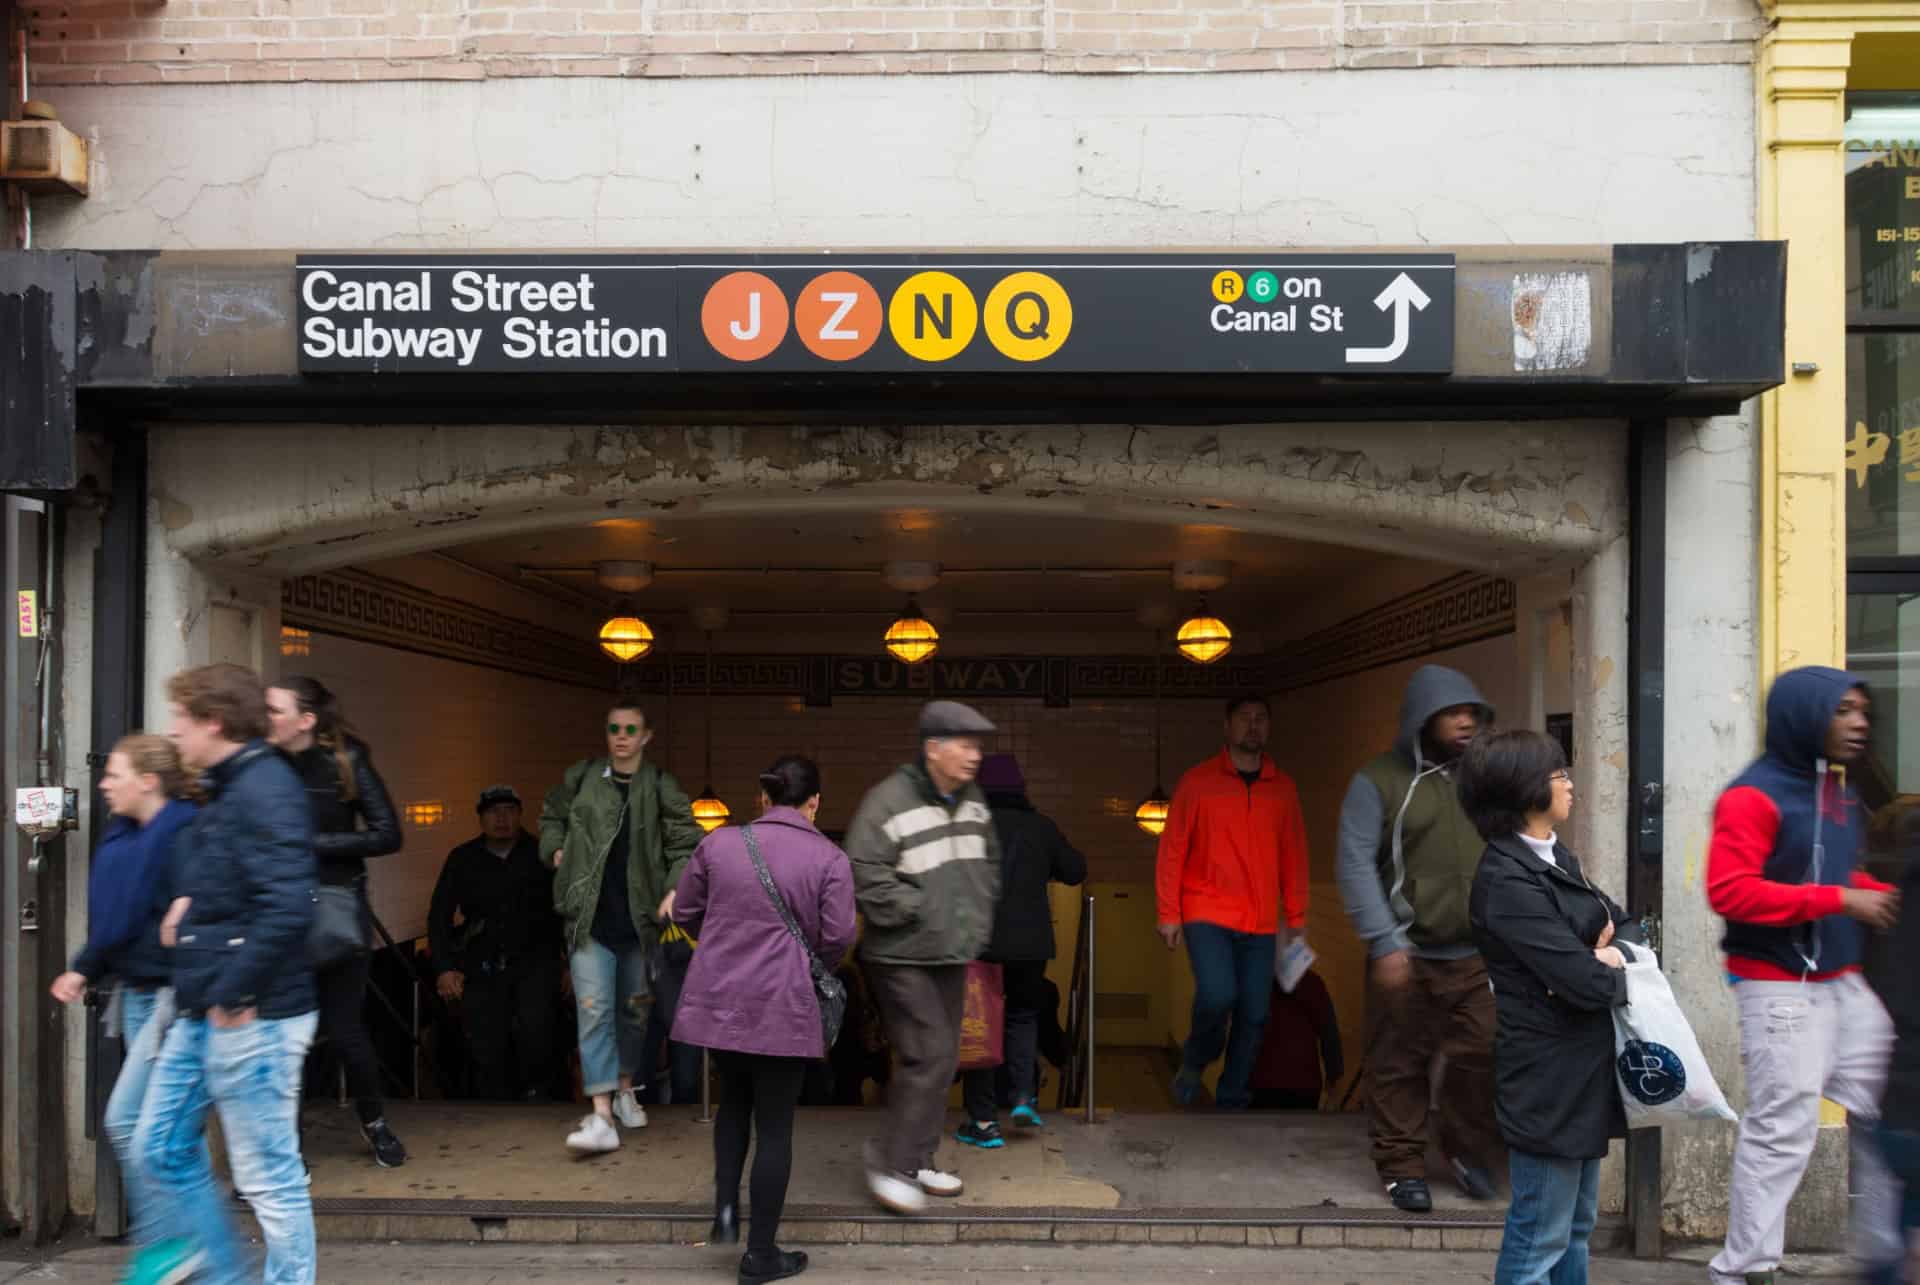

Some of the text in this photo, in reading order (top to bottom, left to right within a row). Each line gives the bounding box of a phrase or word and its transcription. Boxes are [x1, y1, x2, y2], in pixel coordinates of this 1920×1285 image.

[303, 271, 594, 312] Canal Street
[1283, 278, 1321, 298] on
[1211, 304, 1343, 332] Canal St
[304, 317, 666, 365] Subway Station
[20, 596, 33, 633] EASY
[840, 663, 1036, 689] SUBWAY
